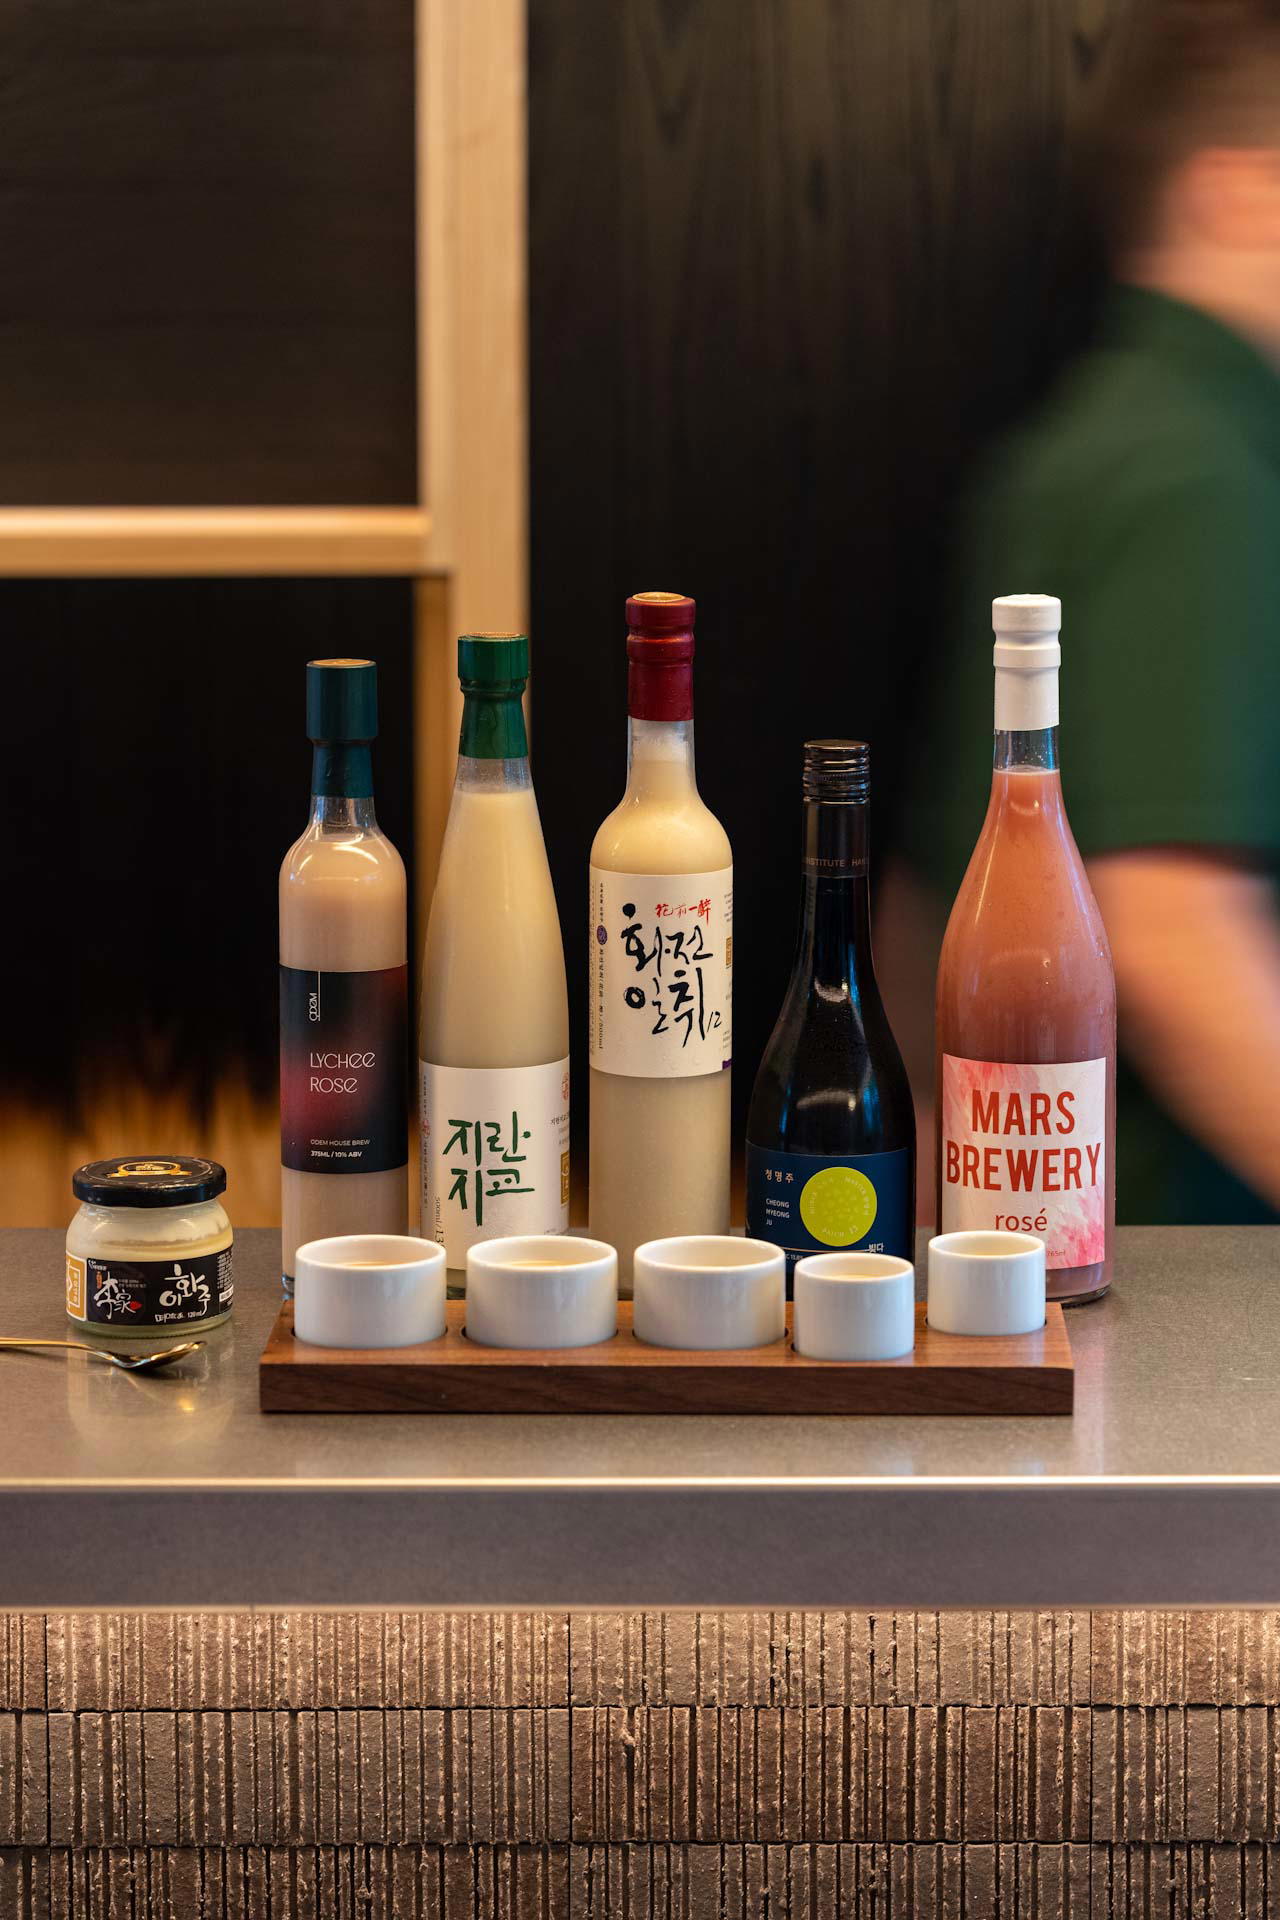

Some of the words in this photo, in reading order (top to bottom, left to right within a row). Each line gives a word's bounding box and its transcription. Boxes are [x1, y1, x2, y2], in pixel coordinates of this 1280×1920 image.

[971, 1089, 1076, 1136] MARS
[310, 1138, 329, 1147] ODEM
[329, 1139, 351, 1147] HOUSE
[310, 1150, 331, 1158] 375ML
[945, 1140, 1102, 1193] BREWERY
[765, 1197, 790, 1209] CHEONG
[765, 1208, 790, 1219] MYEONG
[765, 1218, 773, 1226] JU
[994, 1207, 1048, 1233] rosé
